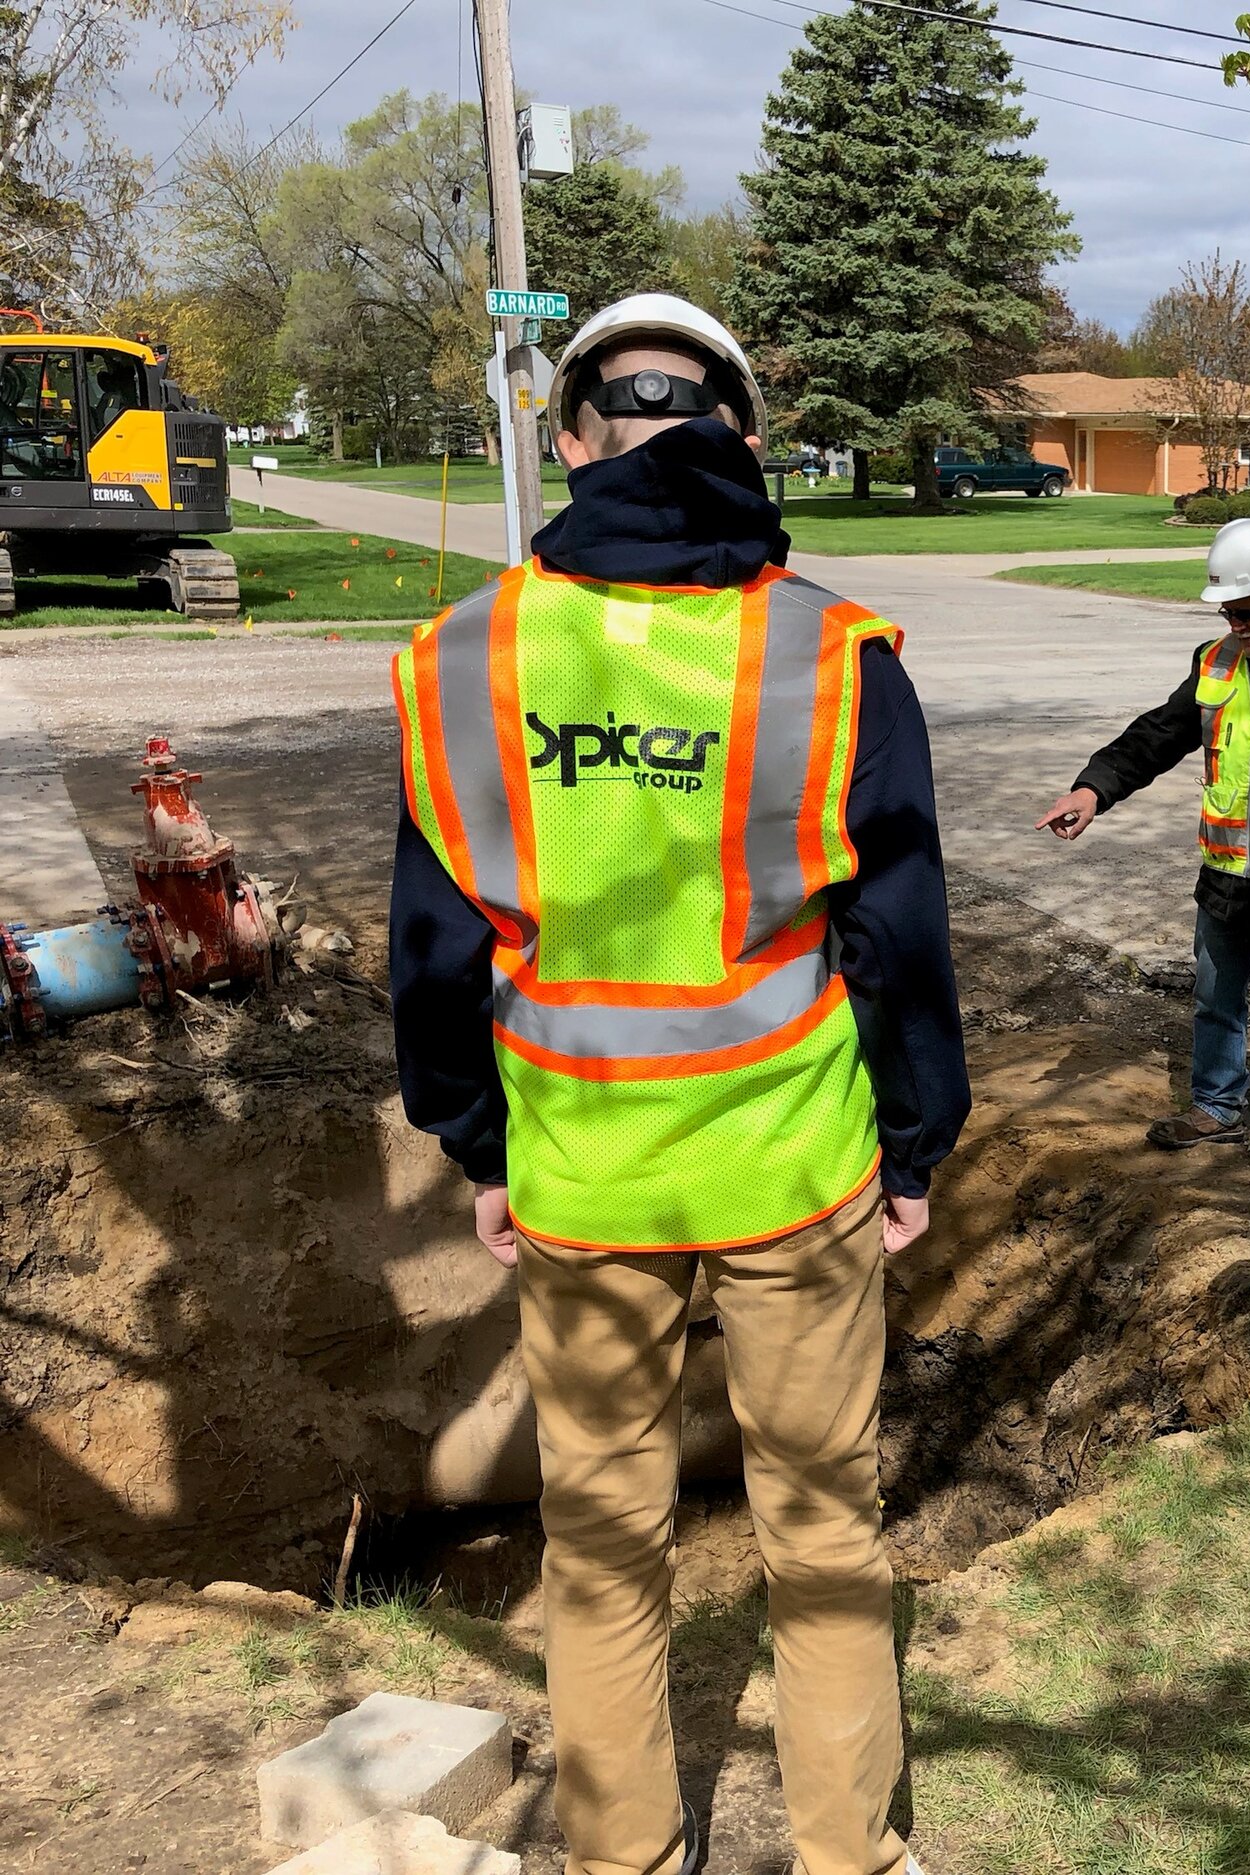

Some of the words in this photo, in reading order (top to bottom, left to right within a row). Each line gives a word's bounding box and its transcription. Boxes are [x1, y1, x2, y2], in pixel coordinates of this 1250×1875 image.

[489, 293, 555, 315] BARNARD
[556, 301, 566, 312] RD
[97, 471, 131, 482] ALTA
[525, 711, 720, 787] Spicer
[633, 772, 703, 794] group
